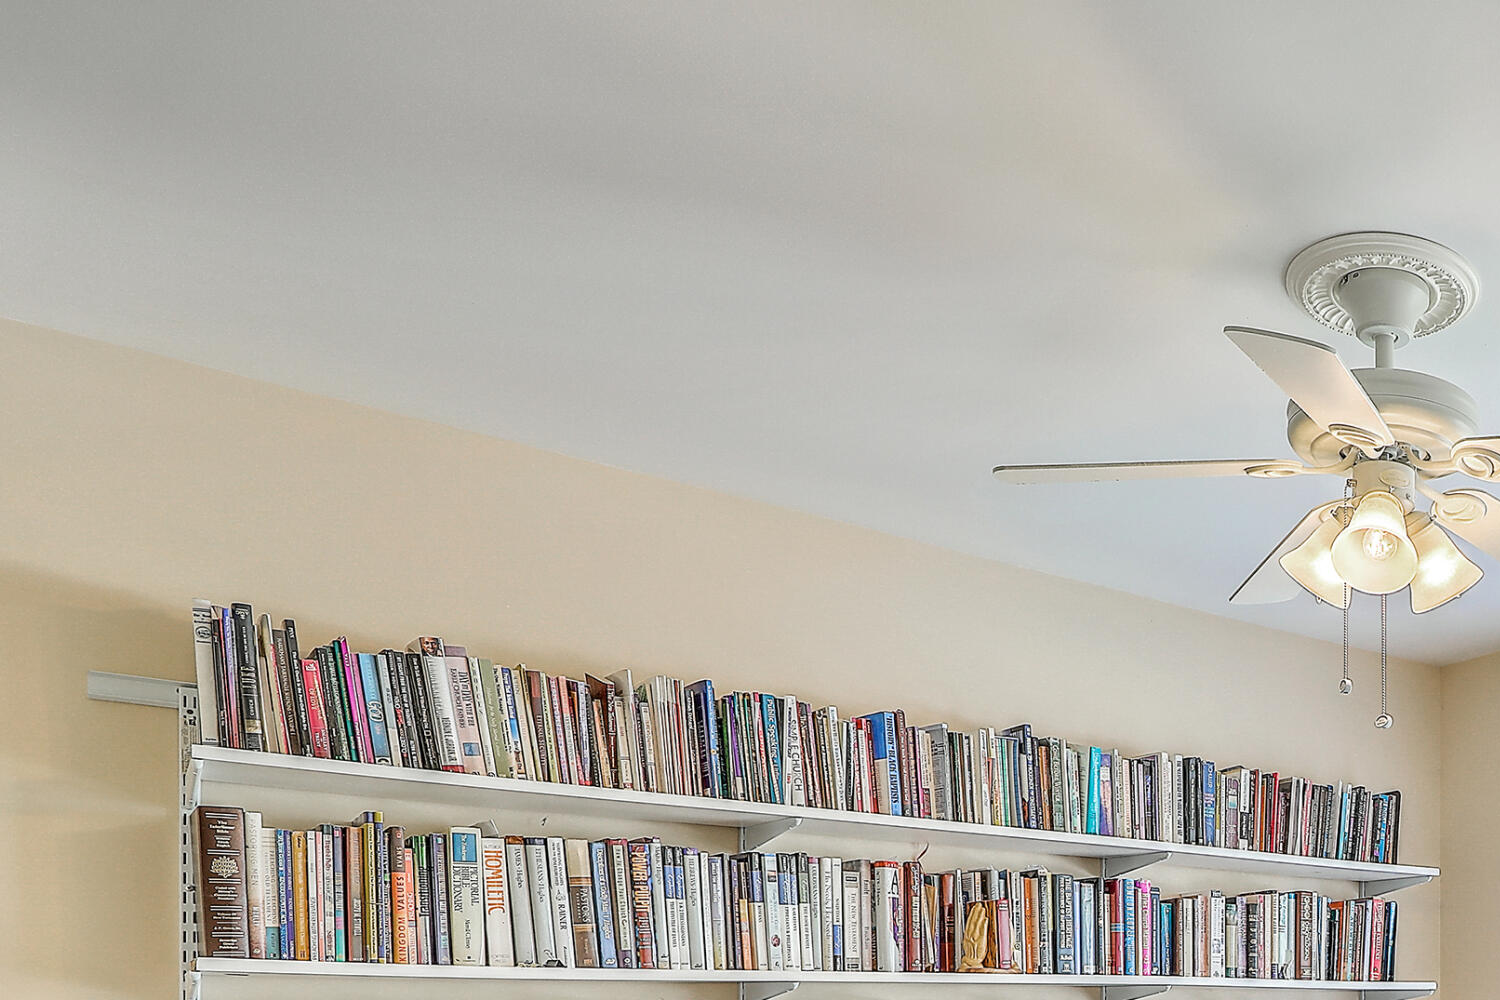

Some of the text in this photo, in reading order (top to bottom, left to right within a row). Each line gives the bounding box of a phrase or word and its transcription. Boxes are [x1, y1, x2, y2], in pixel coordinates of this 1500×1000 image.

[369, 701, 383, 721] GOD
[769, 724, 777, 758] Speaking
[792, 752, 802, 791] CHURCH
[452, 866, 462, 913] DICTIONARY
[461, 866, 469, 888] BIBLE
[471, 866, 479, 906] PICTORIAL
[484, 850, 505, 915] HOMILETIC
[632, 852, 650, 913] POWER PULPIT
[396, 876, 406, 962] KINGDOM VALUES
[579, 888, 591, 923] PASTOR'S
